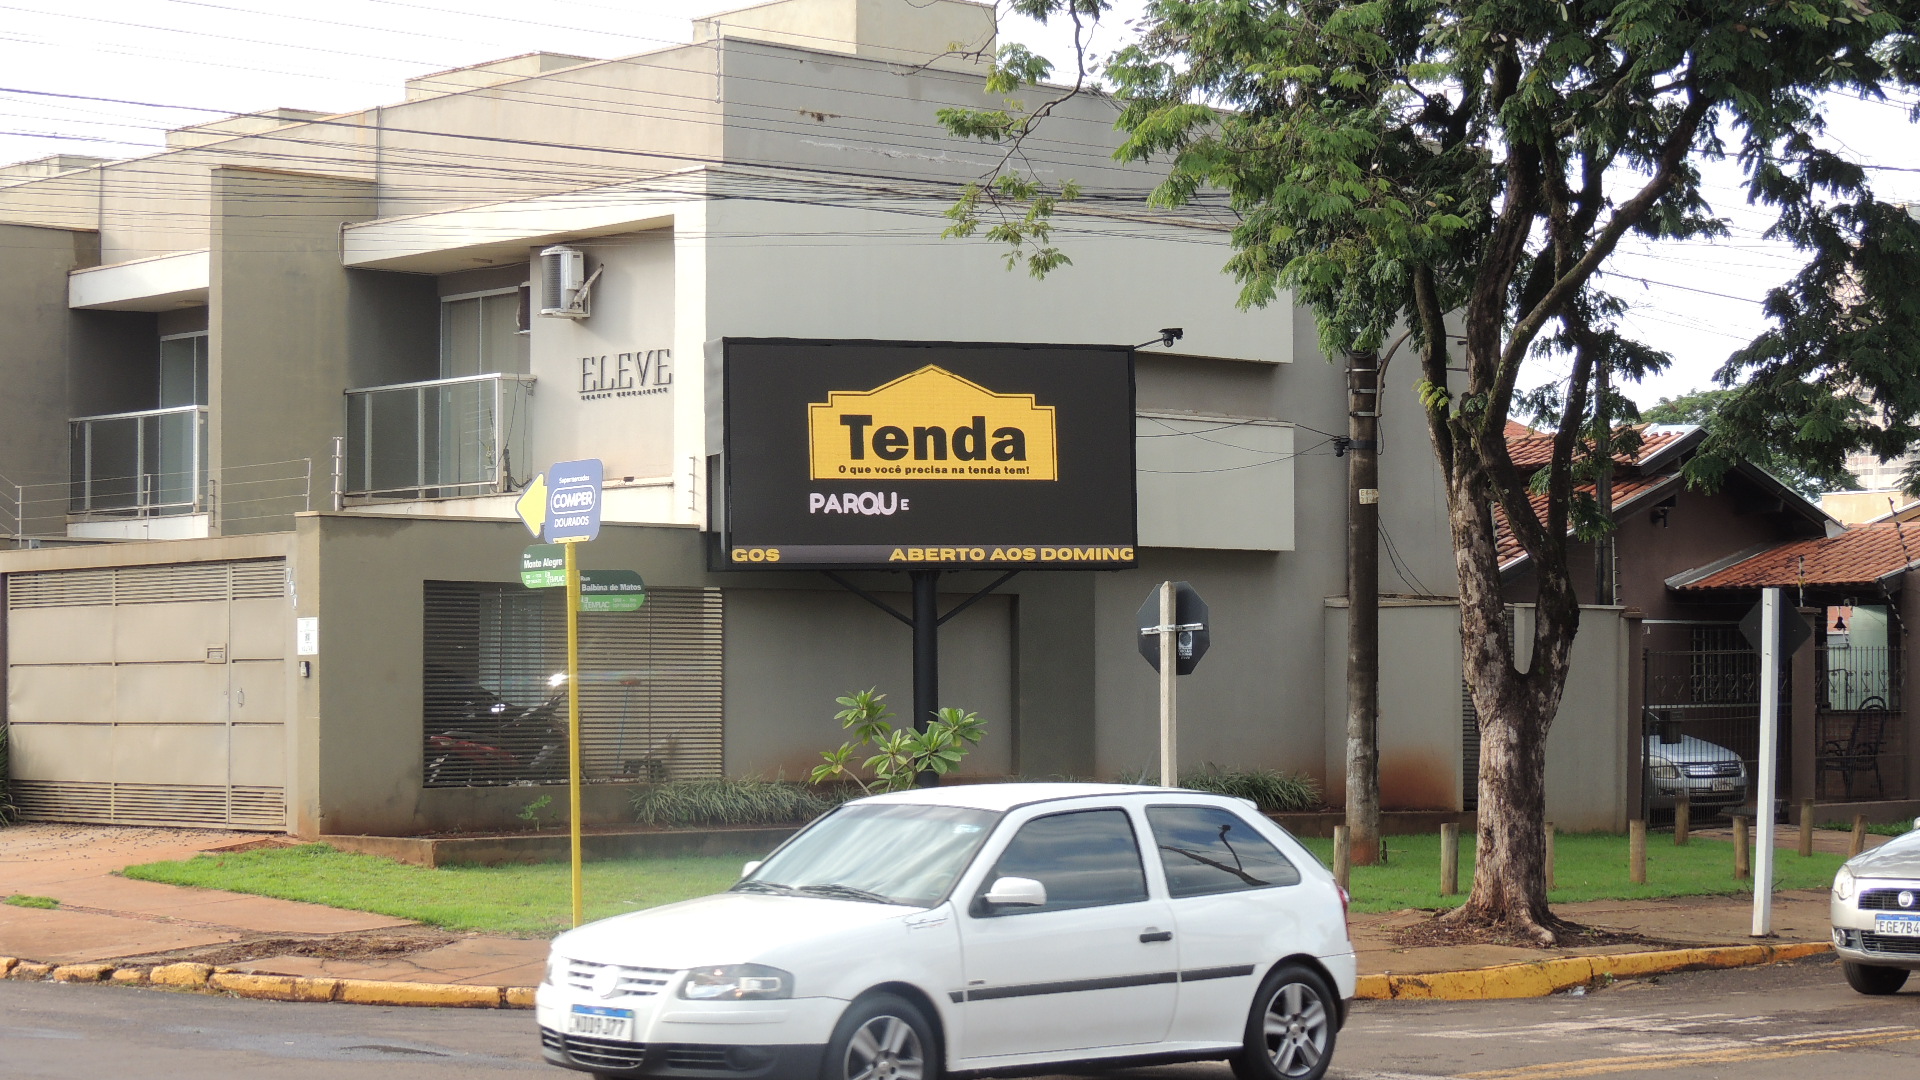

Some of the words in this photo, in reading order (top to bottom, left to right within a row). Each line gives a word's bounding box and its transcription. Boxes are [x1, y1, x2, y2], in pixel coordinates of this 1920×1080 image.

[577, 349, 672, 393] ELEVE
[840, 414, 1027, 462] Tenda
[838, 465, 846, 474] O
[850, 466, 872, 475] que
[875, 464, 901, 474] você
[905, 465, 948, 475] precisa
[951, 466, 965, 474] na
[968, 465, 1001, 475] tenda
[1004, 466, 1030, 475] tem!
[553, 491, 593, 509] COMPER
[554, 515, 590, 528] DOURADOS
[731, 547, 781, 562] GOS
[888, 547, 986, 562] ABERTO
[989, 547, 1036, 562] AOS
[1040, 547, 1134, 562] DOMING
[523, 560, 542, 569] Monte
[543, 558, 563, 568] Alegre
[581, 583, 608, 592] Balbina
[609, 583, 619, 591] de
[620, 583, 642, 591] Matos
